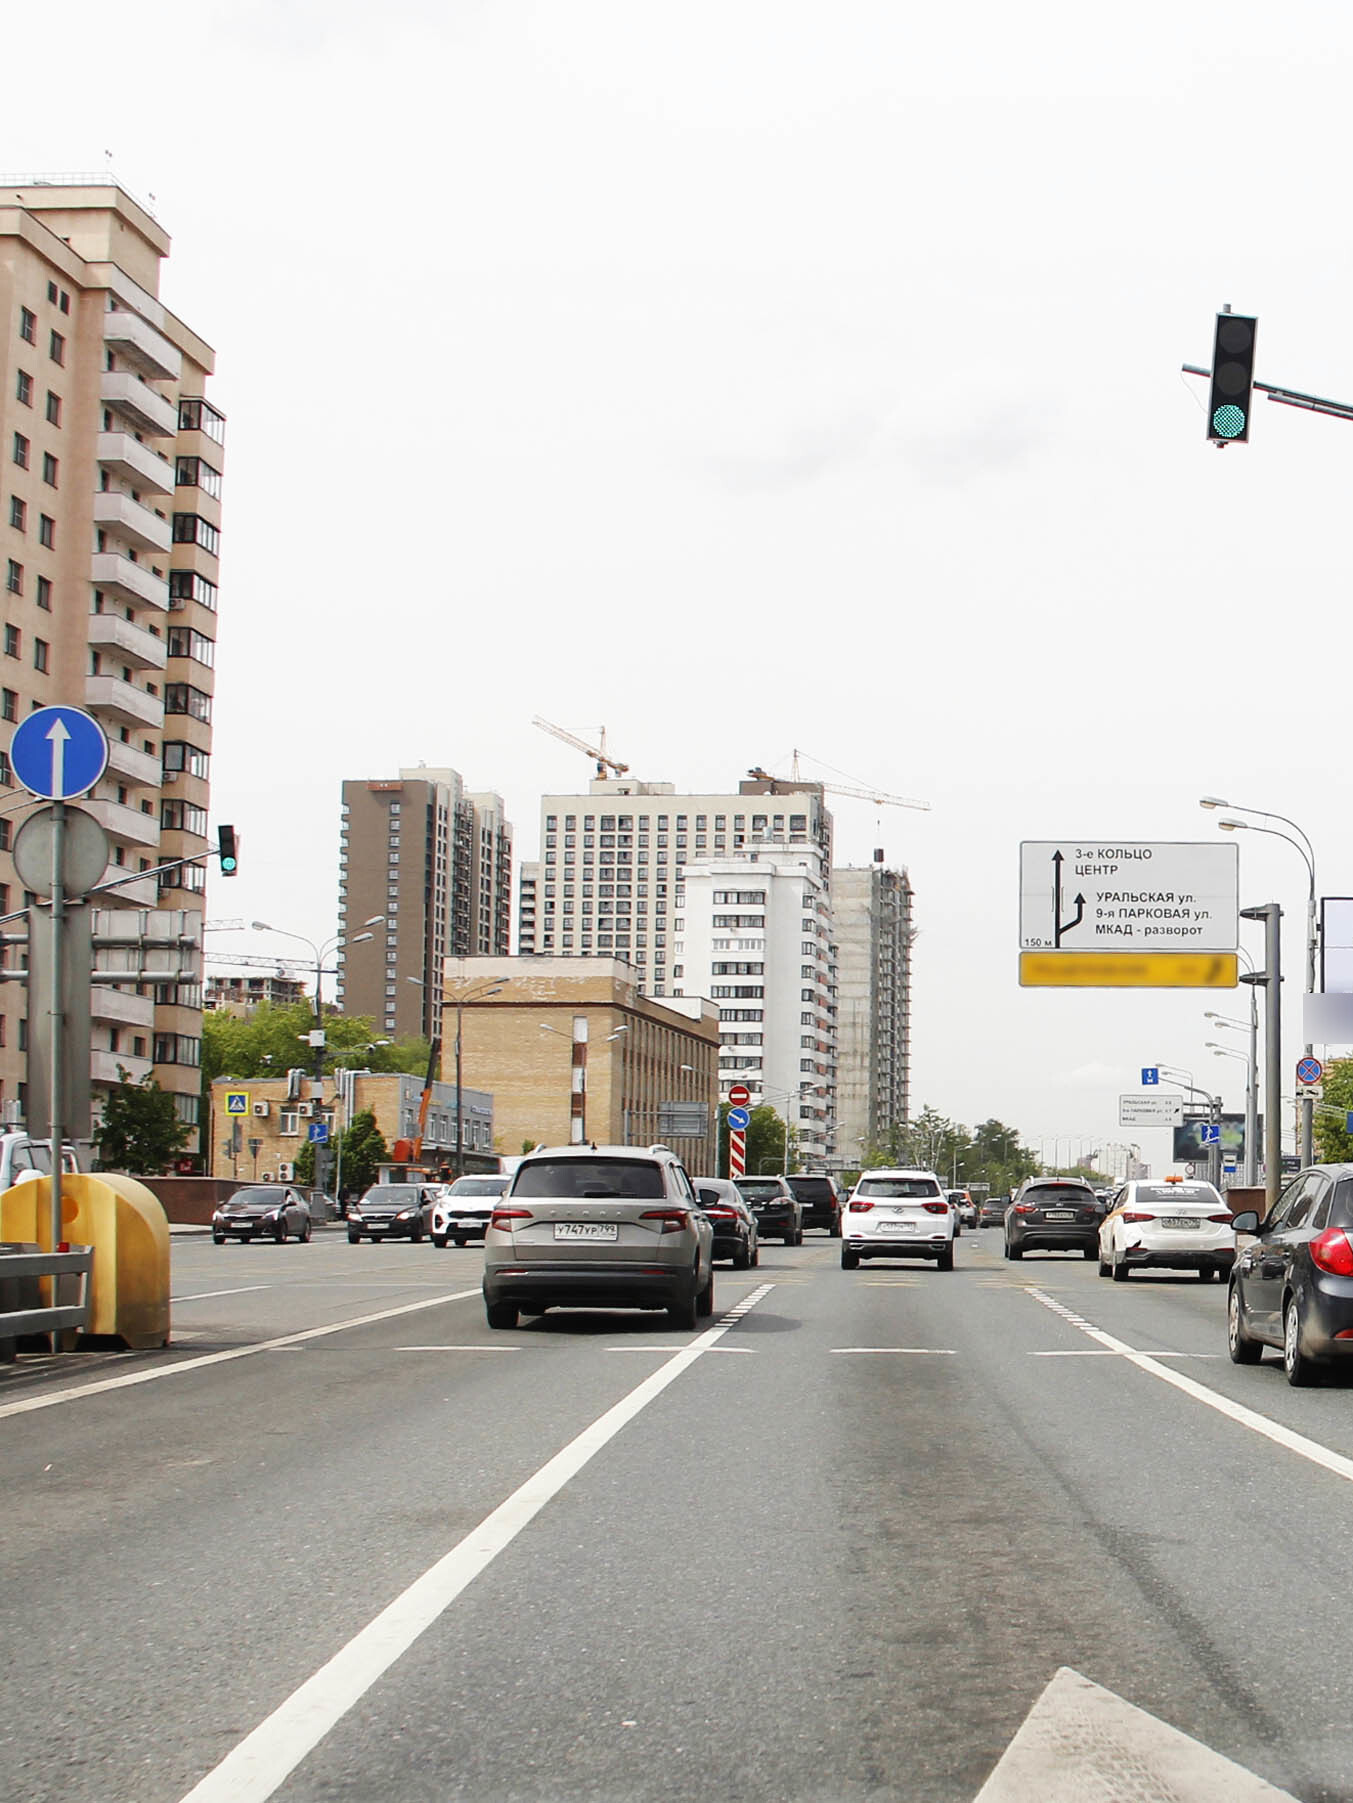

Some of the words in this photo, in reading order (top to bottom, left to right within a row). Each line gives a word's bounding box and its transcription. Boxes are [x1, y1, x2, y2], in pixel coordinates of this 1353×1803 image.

[1075, 848, 1094, 860] 3-е
[1097, 848, 1153, 862] КОЛЬЦО
[1075, 864, 1119, 877] ЦЕНТР
[1096, 892, 1175, 904] УРАЛЬСКАЯ
[1178, 895, 1197, 905] ул.
[1095, 908, 1115, 920] 9-я
[1118, 909, 1190, 920] ПАРКОВАЯ
[1194, 911, 1213, 922] ул.
[1095, 924, 1133, 937] МКАД
[1144, 926, 1204, 938] разворот
[1024, 937, 1042, 948] 150
